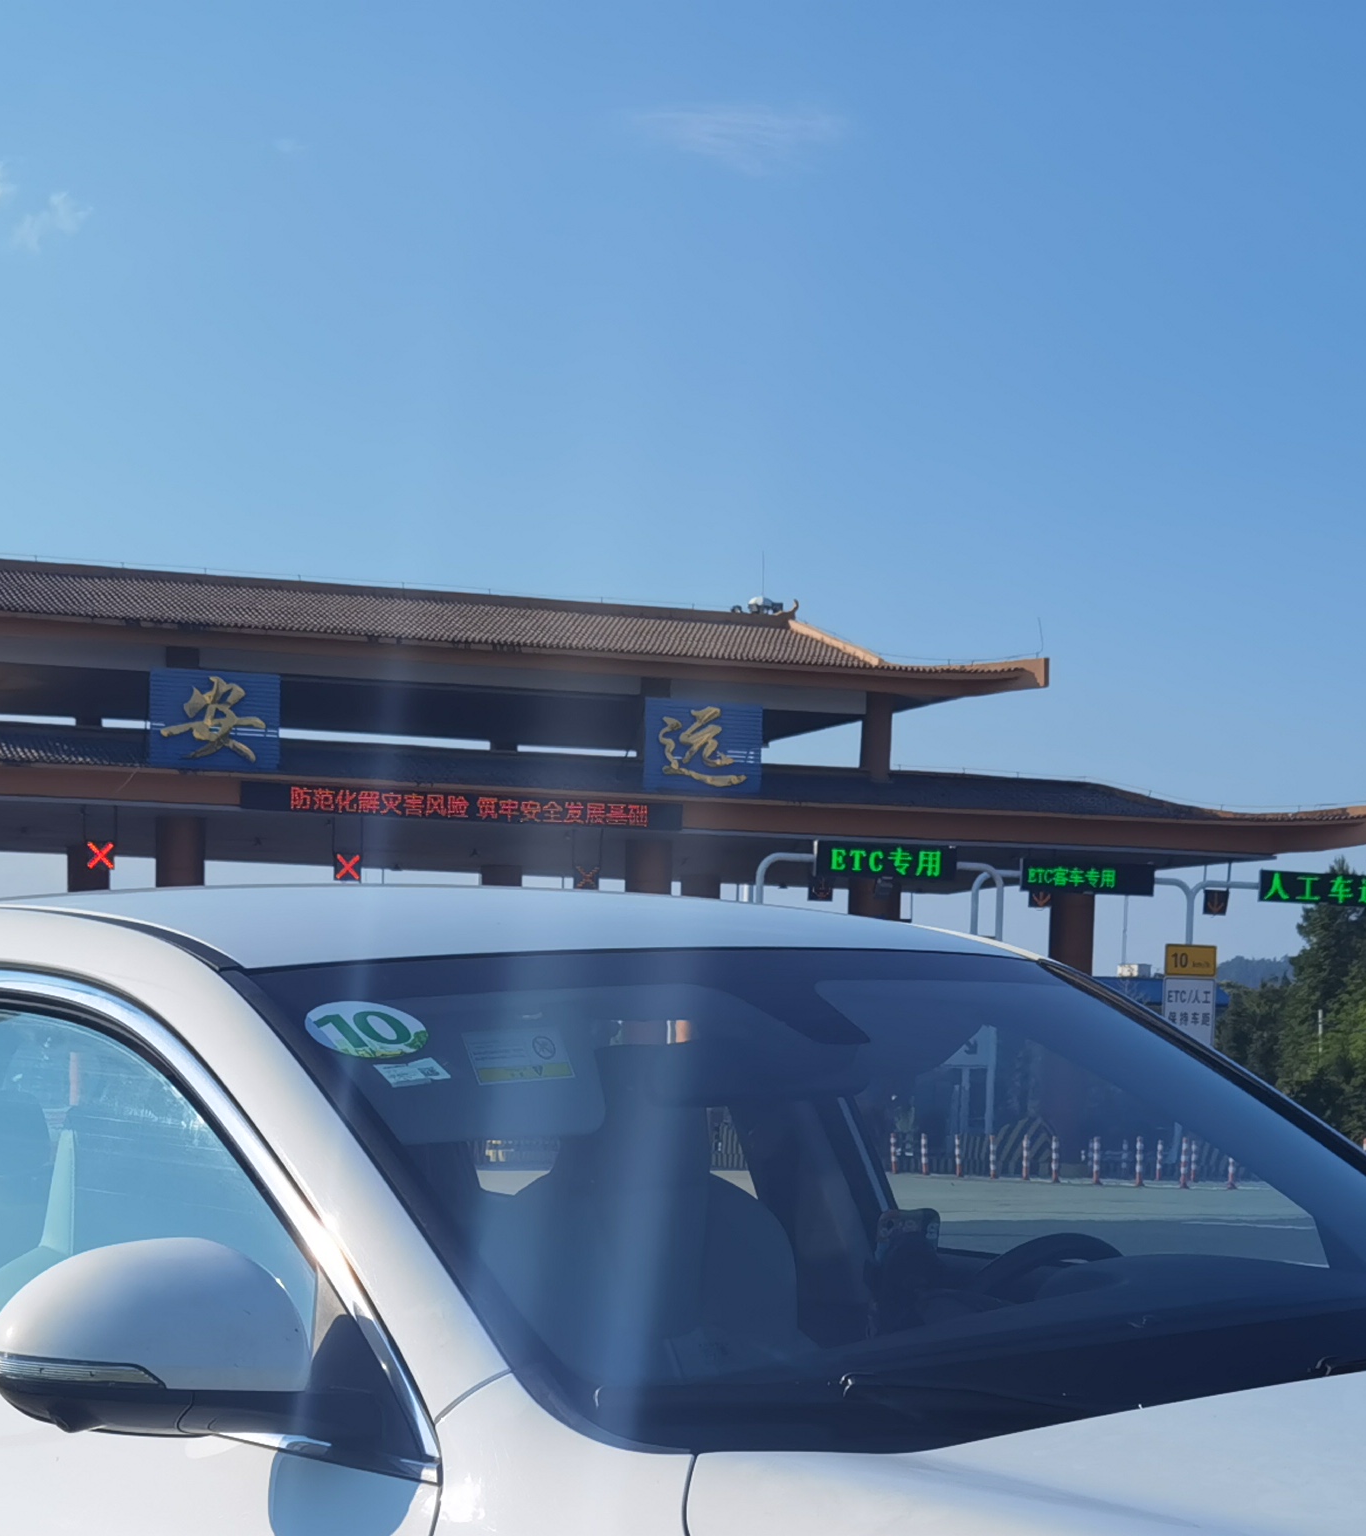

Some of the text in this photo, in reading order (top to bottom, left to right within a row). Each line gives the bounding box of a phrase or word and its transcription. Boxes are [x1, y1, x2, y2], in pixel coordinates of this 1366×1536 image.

[159, 674, 748, 788] 安 远
[289, 785, 649, 828] 防范化解灾害风险 筑牢安全发展基础
[829, 846, 942, 877] ETC专用
[1026, 865, 1117, 889] ETC客车专用
[1171, 952, 1189, 969] 10
[1166, 989, 1212, 1005] ETC/人工
[315, 1010, 412, 1049] 10
[1167, 1010, 1211, 1027] 保持车距
